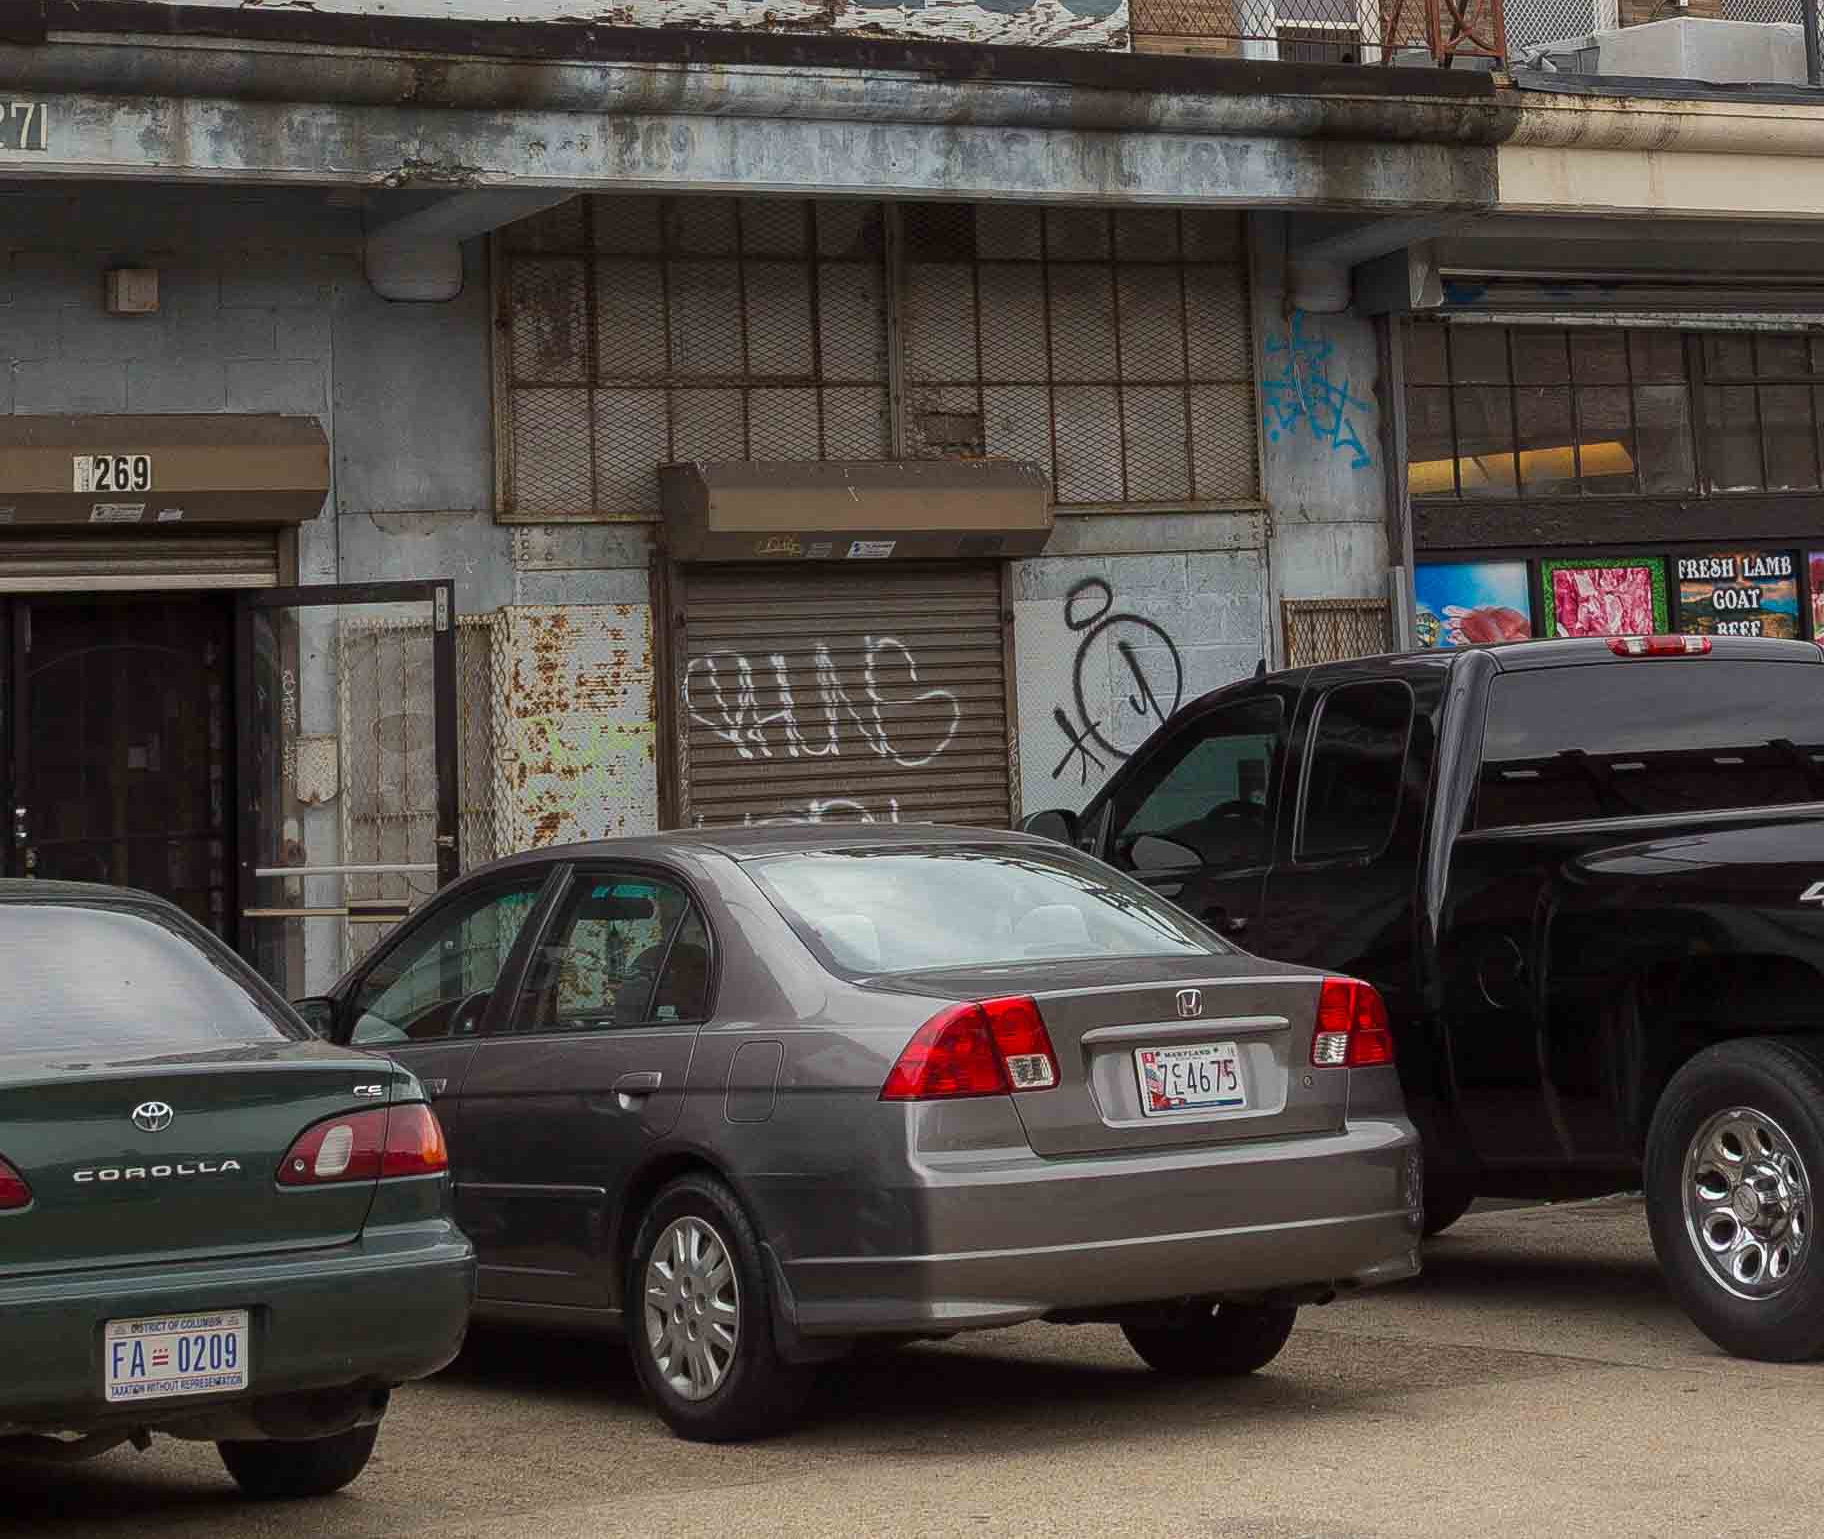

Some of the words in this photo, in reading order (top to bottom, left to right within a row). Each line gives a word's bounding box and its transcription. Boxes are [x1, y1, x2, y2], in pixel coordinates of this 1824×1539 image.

[1678, 557, 1735, 579] FRESH
[1742, 555, 1792, 577] LAMB
[1712, 588, 1761, 610] GOAT
[353, 1084, 383, 1098] CE
[72, 1159, 242, 1183] COROLLA
[112, 1340, 145, 1379] FA
[178, 1332, 237, 1373] 0209
